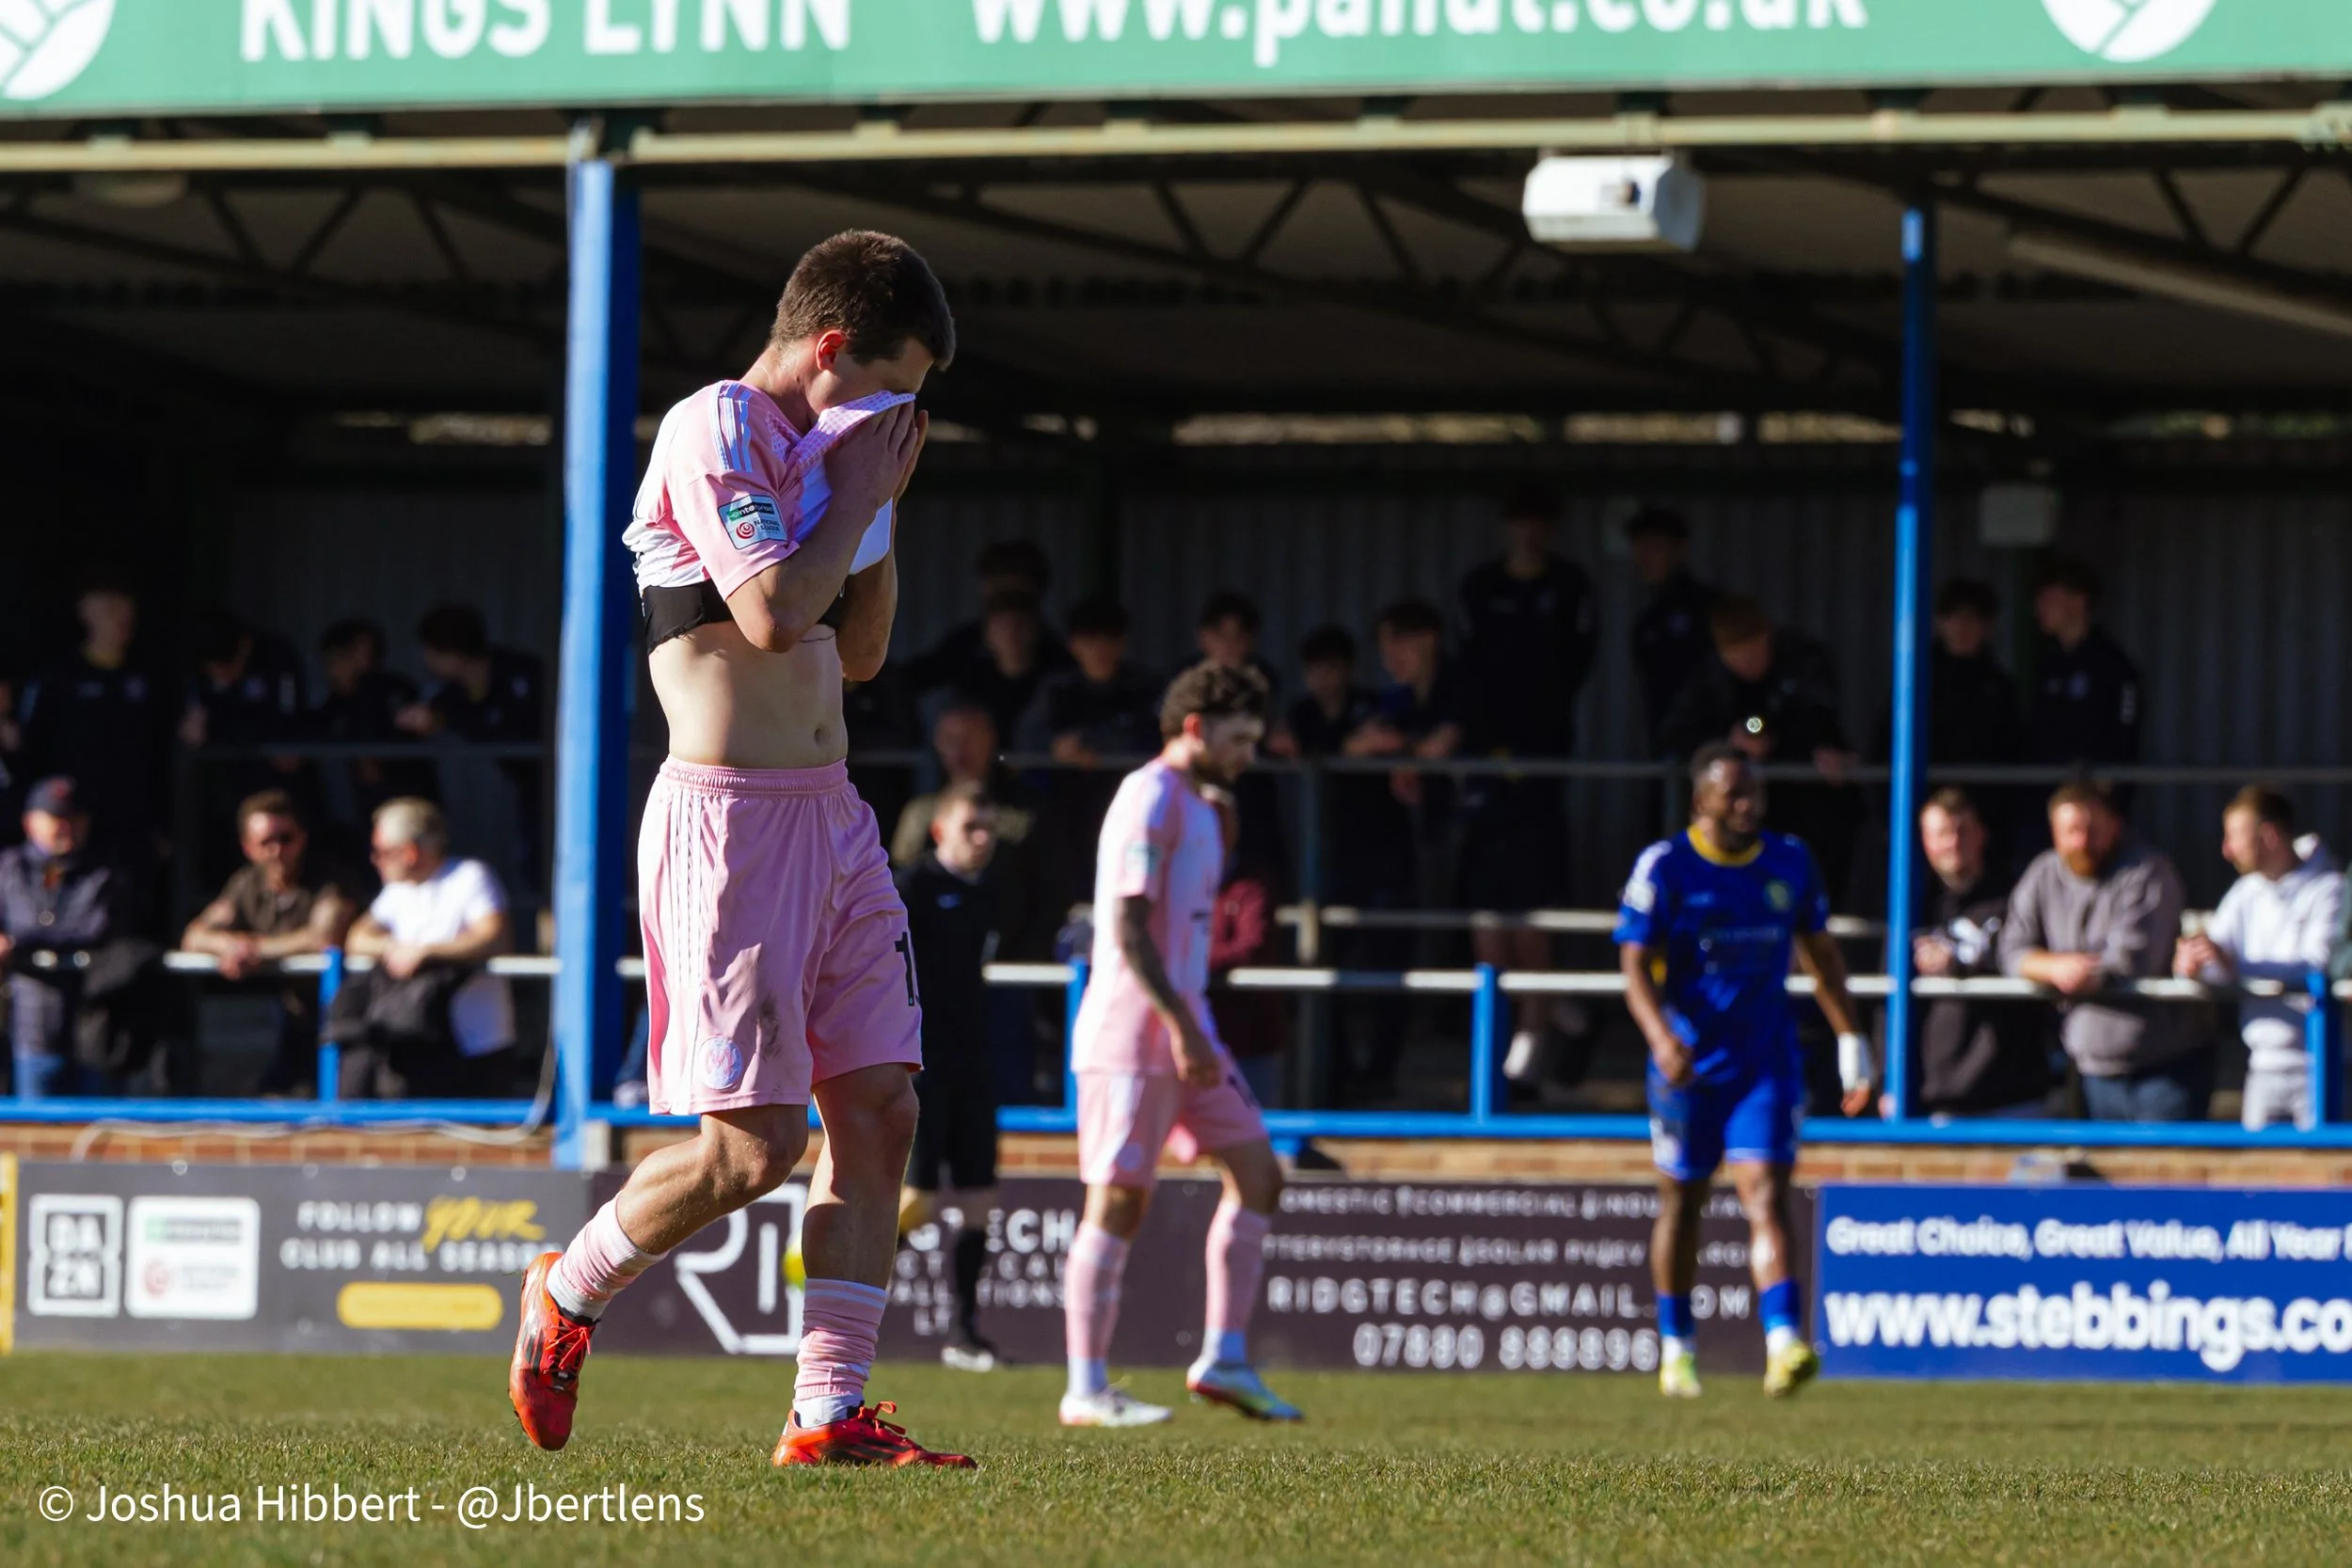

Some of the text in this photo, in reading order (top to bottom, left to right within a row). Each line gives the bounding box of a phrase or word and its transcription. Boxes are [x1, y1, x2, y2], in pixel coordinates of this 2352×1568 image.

[239, 0, 551, 62] KINGS
[895, 931, 920, 1006] 1
[296, 1199, 422, 1233] FOLLOW
[1826, 1216, 1915, 1256] Great
[1916, 1216, 2033, 1261] Choice,
[2034, 1219, 2124, 1258] Great
[2125, 1220, 2224, 1263] Value,
[2226, 1220, 2269, 1260] All
[2270, 1222, 2342, 1260] Year
[279, 1236, 362, 1271] CLUB
[370, 1239, 429, 1272] ALL
[1266, 1275, 1753, 1322] RIDGTECH@GMAIL.OM
[1823, 1279, 2352, 1372] www.stebbings.co
